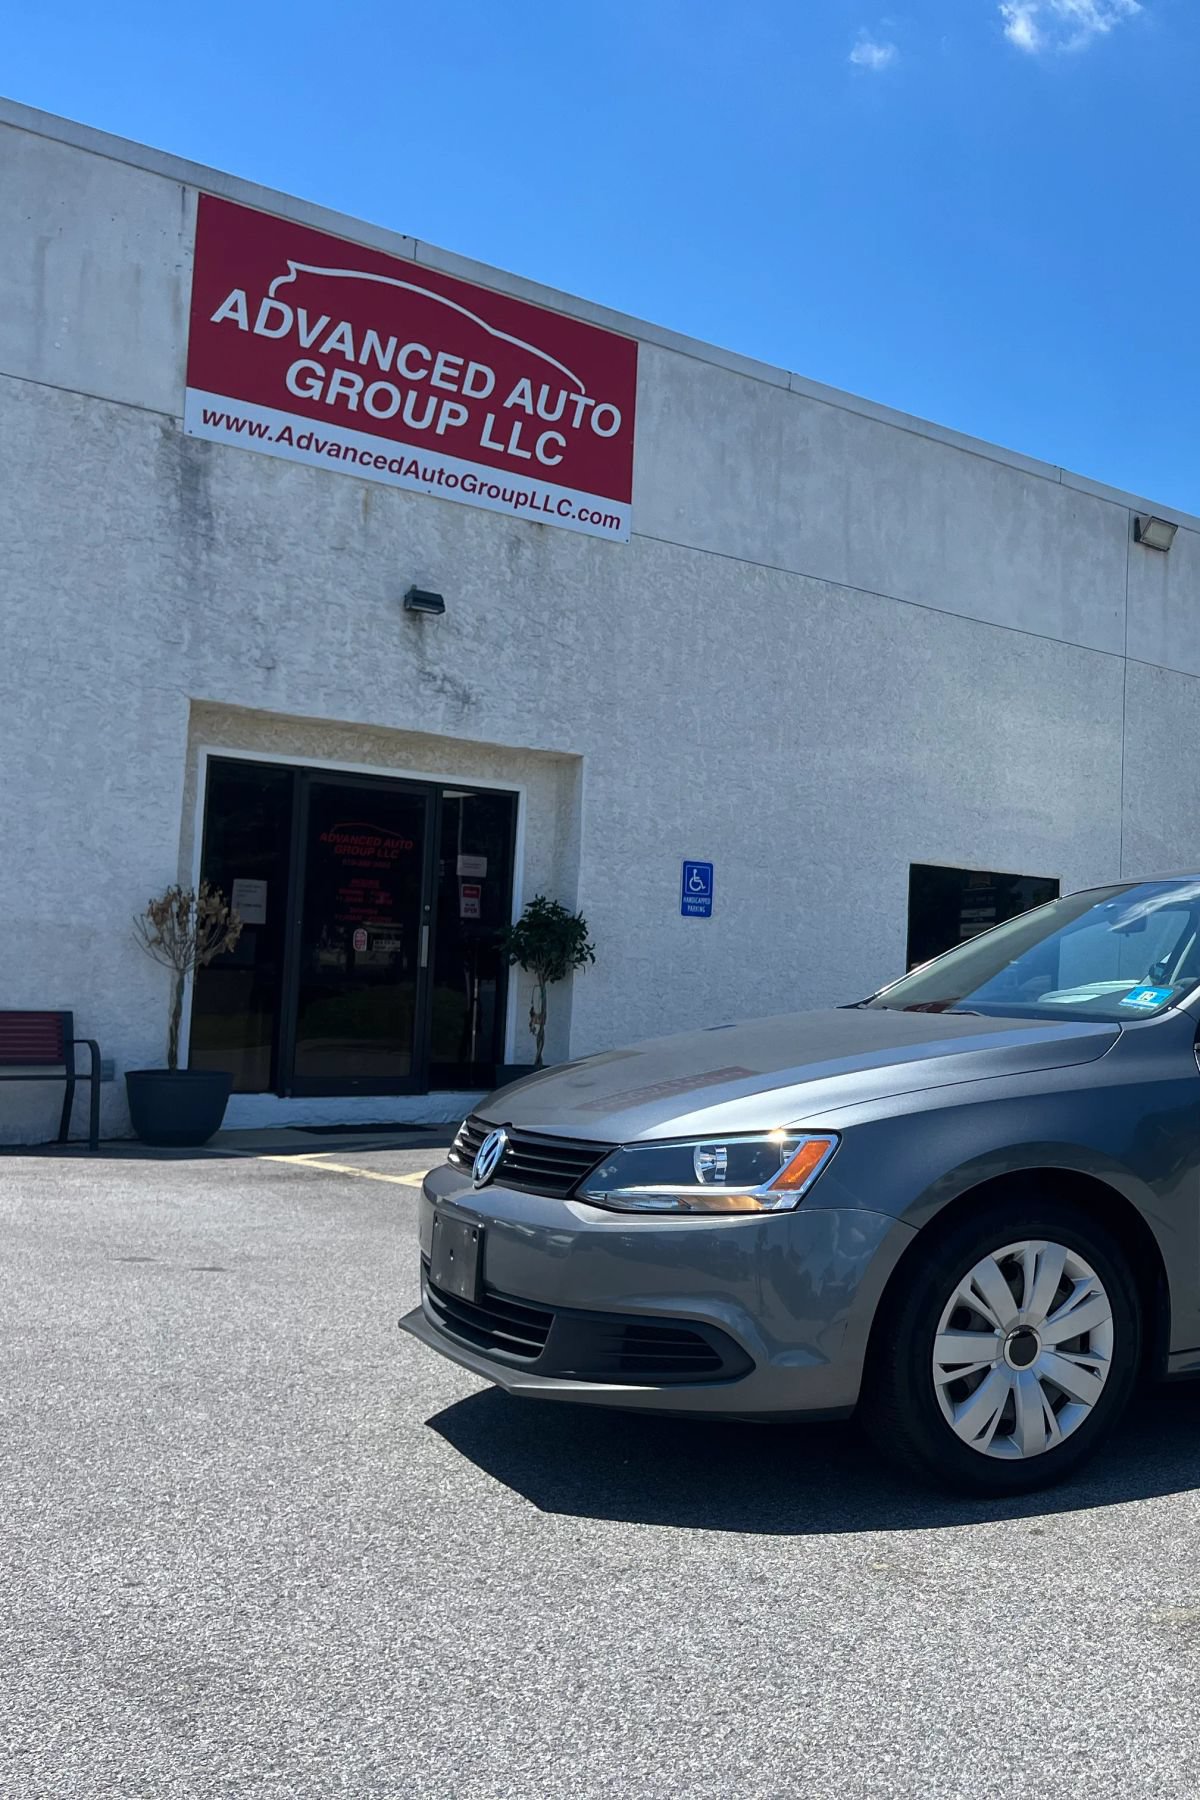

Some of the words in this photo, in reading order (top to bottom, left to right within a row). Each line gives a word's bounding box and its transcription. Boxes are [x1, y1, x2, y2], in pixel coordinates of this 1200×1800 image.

[209, 288, 495, 400] ADVANCED
[502, 376, 622, 438] AUTO
[285, 358, 469, 436] GROUP
[479, 412, 567, 466] LLC
[201, 407, 622, 531] www.AdvancedAutoGroupLLC.com
[319, 832, 382, 847] ADVANCED
[383, 838, 414, 849] AUTO
[335, 844, 375, 857] GROUP
[376, 848, 400, 859] LLC
[687, 904, 706, 913] PARKING
